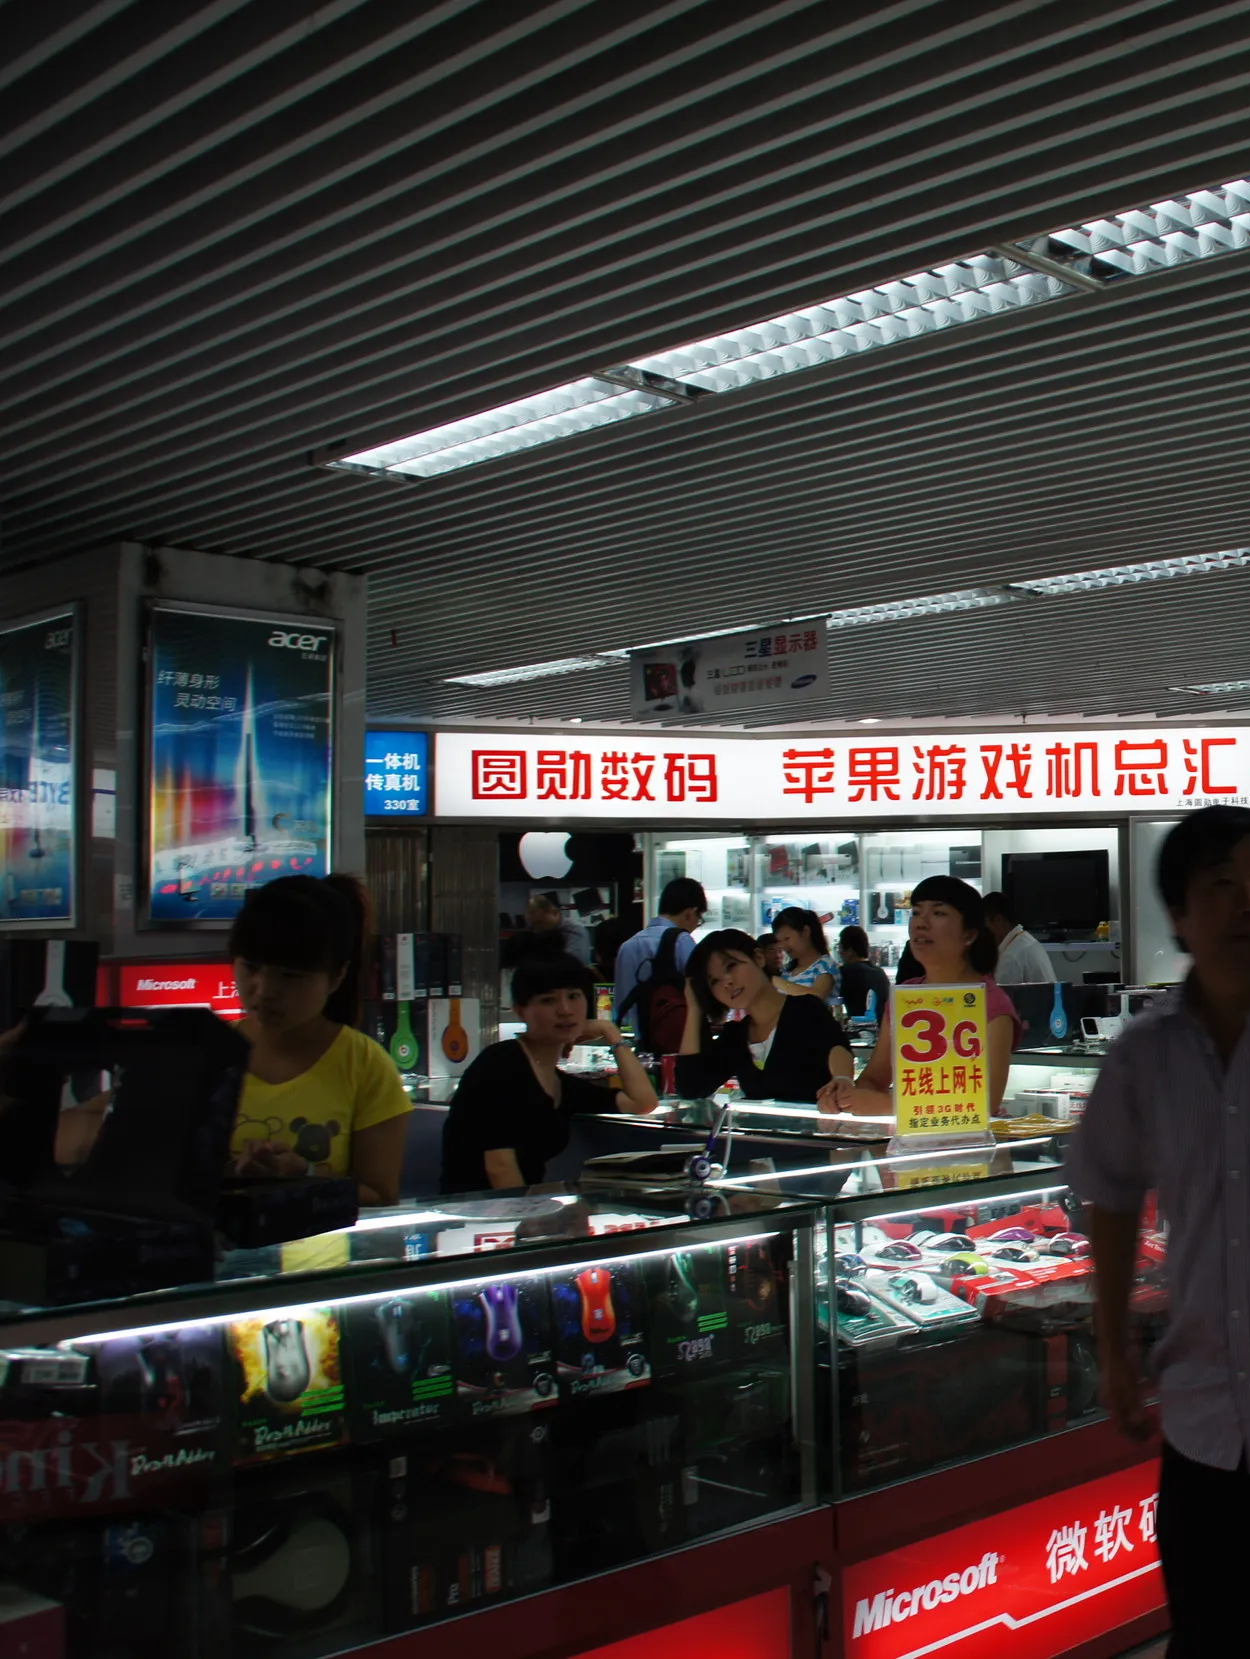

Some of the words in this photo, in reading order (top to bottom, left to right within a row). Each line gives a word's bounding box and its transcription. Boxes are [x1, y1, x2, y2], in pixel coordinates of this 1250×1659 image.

[268, 630, 328, 653] acer
[744, 630, 817, 659] 三星显示器
[157, 669, 220, 691] 纤薄身形
[173, 691, 237, 714] 灵动空间
[472, 749, 718, 803] 圆勋数码
[783, 738, 1238, 804] 苹果游戏机总汇
[365, 774, 421, 792] 传真机
[383, 799, 421, 812] 330室
[137, 978, 197, 992] Microsoft
[900, 1009, 983, 1064] 3G
[902, 1064, 983, 1097] 无线上网卡
[908, 1114, 981, 1132] 指定业务代办点
[852, 1551, 1000, 1640] Microsoft
